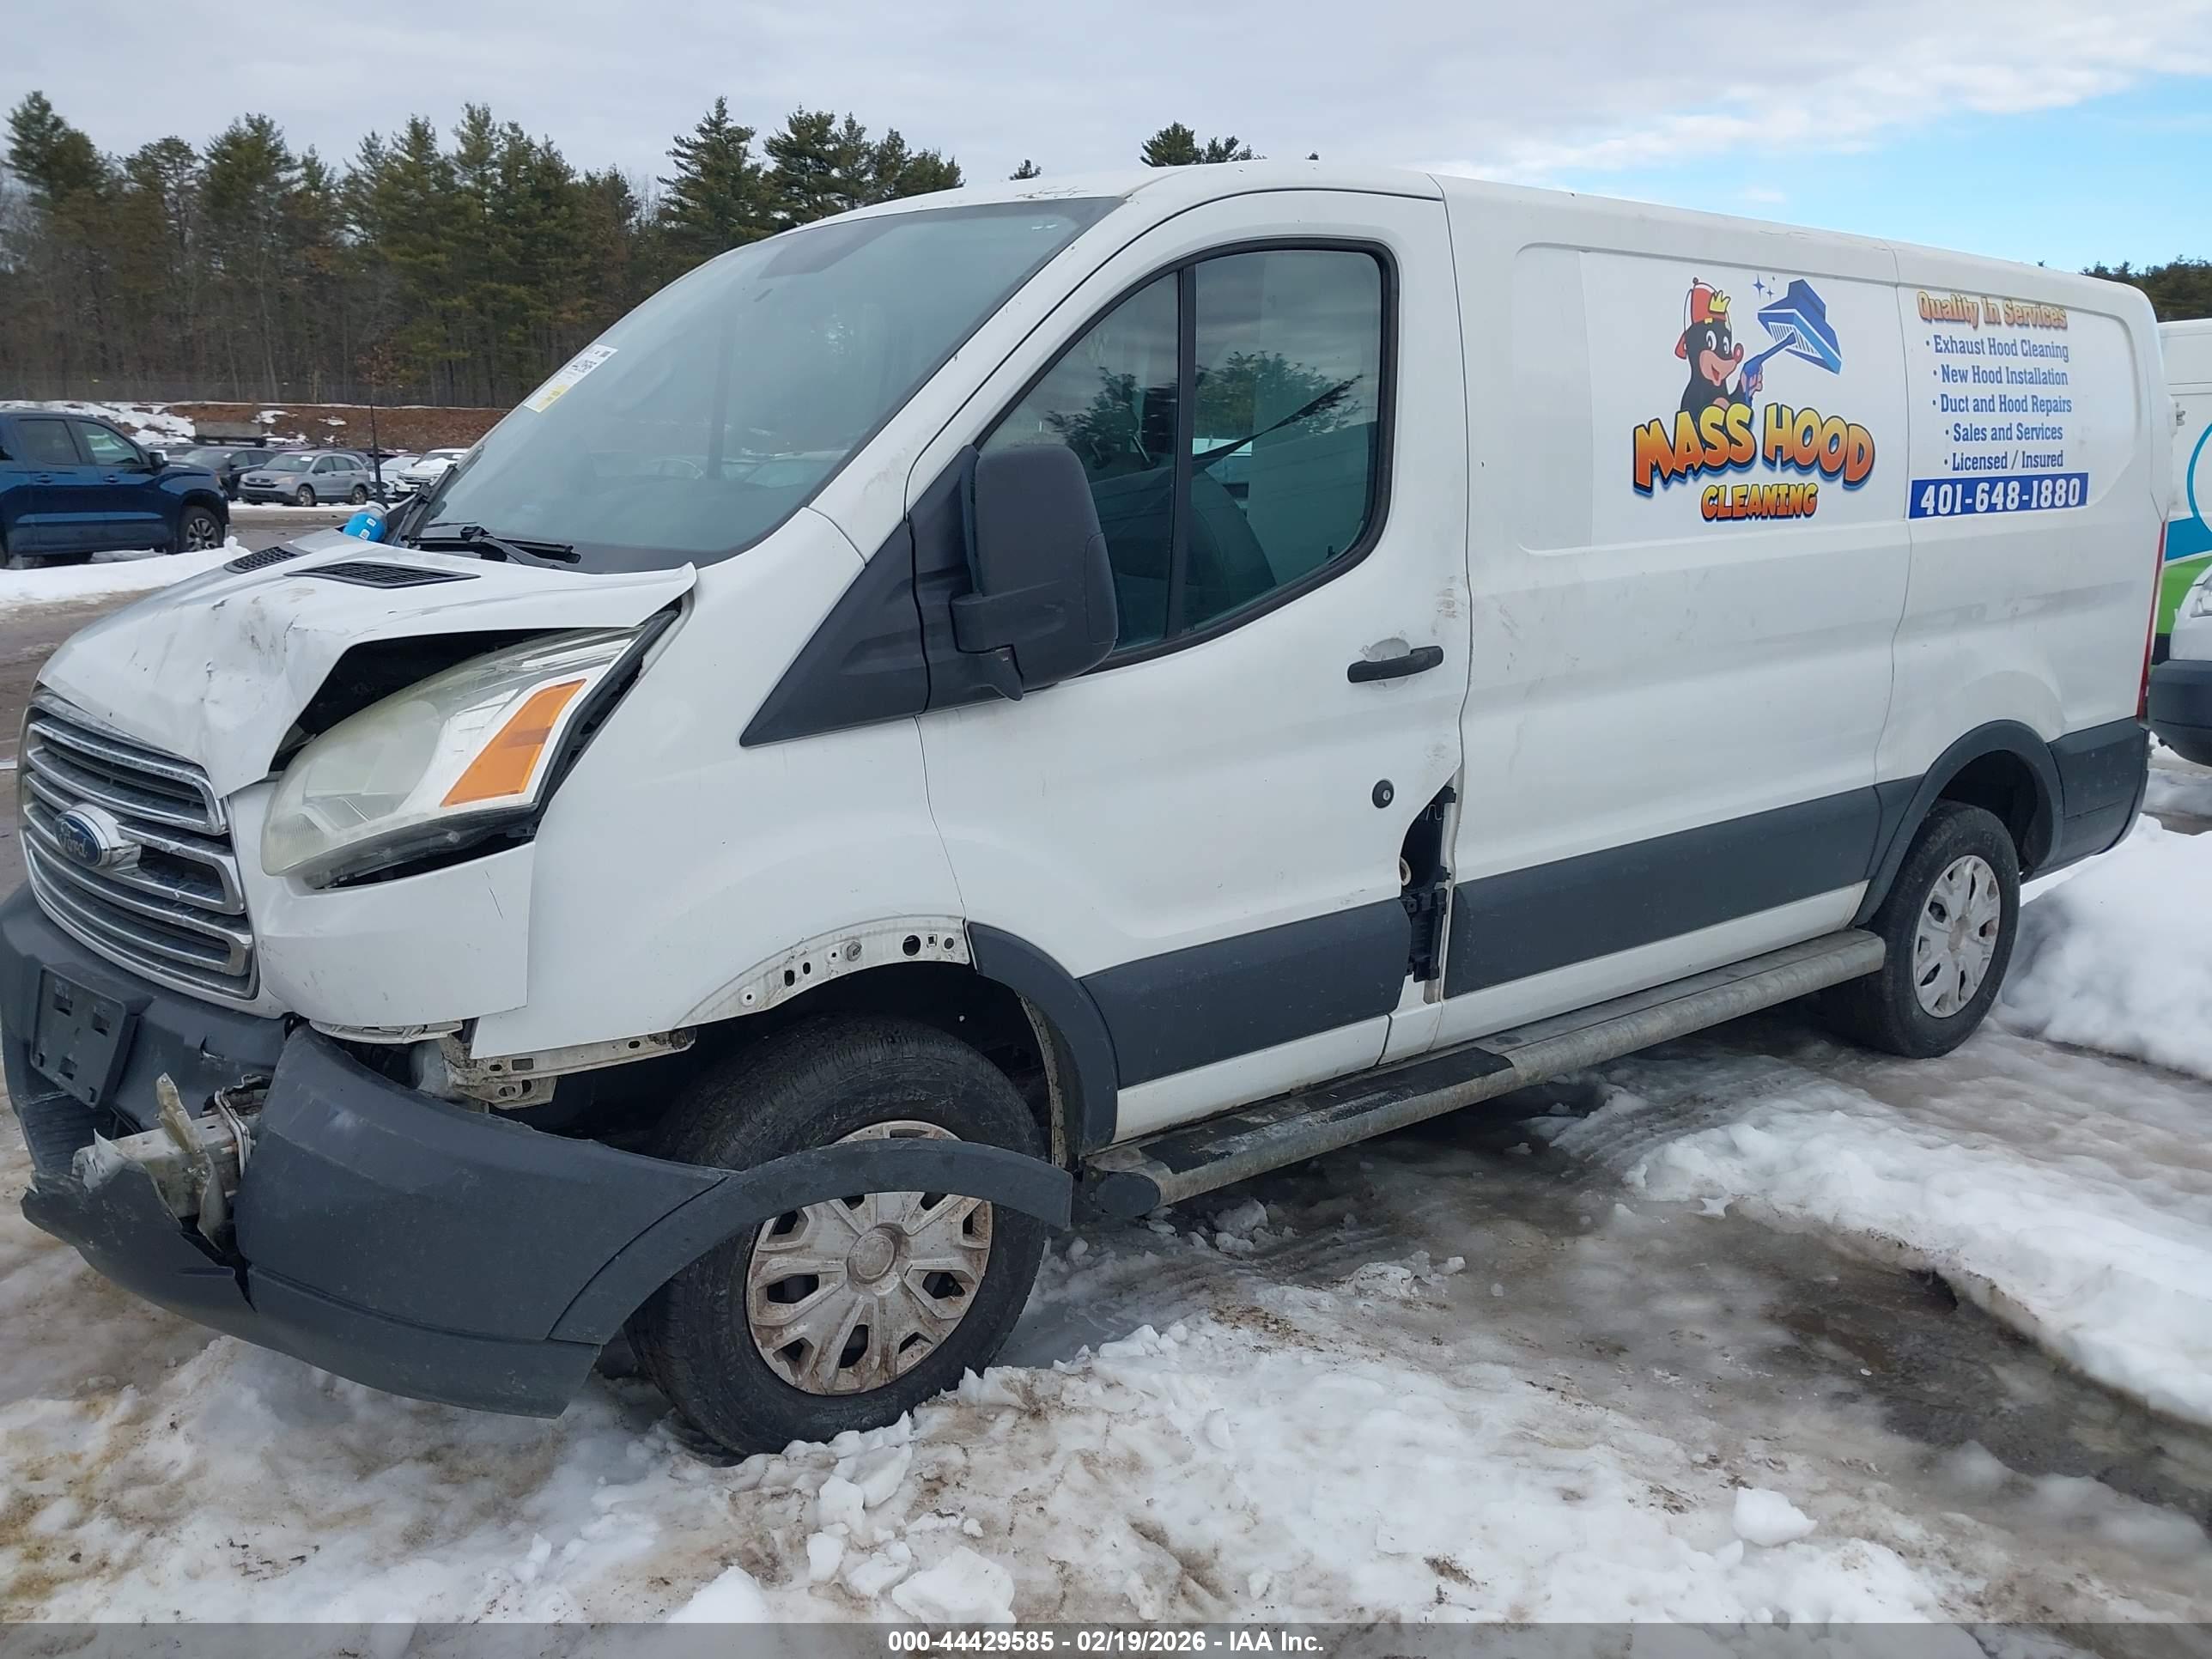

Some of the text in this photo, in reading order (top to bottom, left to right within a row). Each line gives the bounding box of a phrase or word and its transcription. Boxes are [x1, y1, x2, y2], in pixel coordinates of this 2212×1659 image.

[1917, 292, 2068, 329] Quality In Services
[1934, 335, 2069, 362] Exhaust Hood Cleaning
[1941, 364, 2069, 386] New Hood Installation
[1941, 393, 2072, 416] Duct and Hood Repairs
[1953, 422, 2063, 441] Sales and Services
[1633, 402, 1875, 495] MASS HOOD
[1952, 452, 2008, 471] Licensed
[2021, 450, 2063, 468] Insured
[1701, 483, 1819, 521] CLEANING
[1920, 477, 2081, 515] 401-648-1880
[60, 821, 88, 858] Ford
